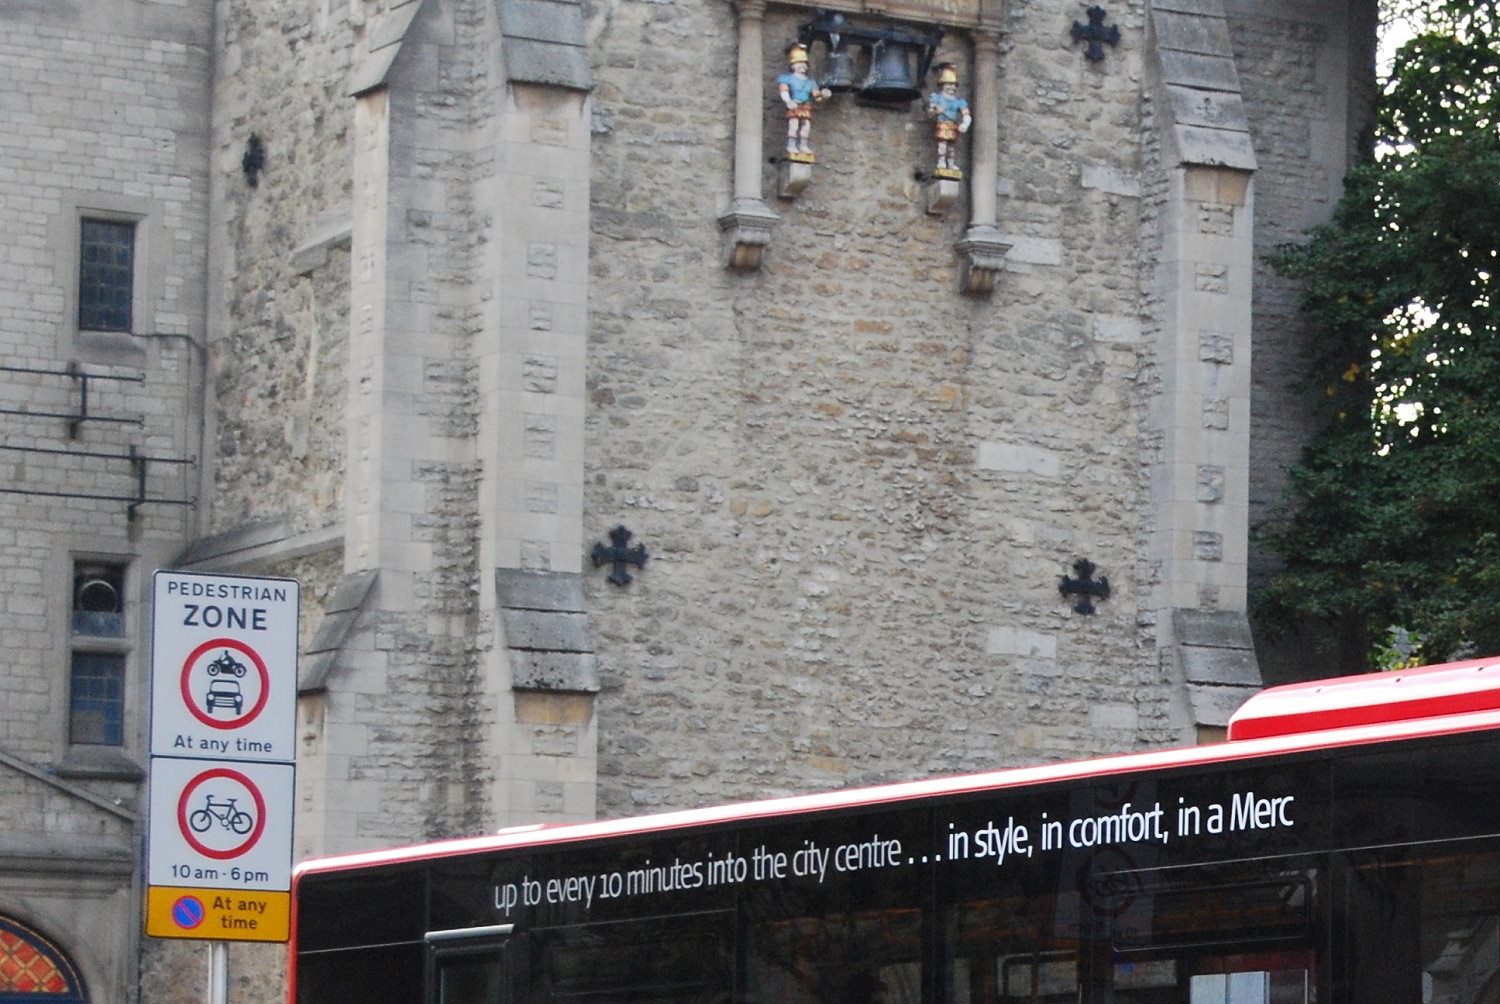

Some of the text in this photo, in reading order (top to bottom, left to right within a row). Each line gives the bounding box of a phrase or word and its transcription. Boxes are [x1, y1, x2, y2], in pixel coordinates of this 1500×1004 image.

[168, 581, 287, 602] PEDESTRIAN
[183, 604, 268, 631] ZONE
[174, 734, 273, 755] At any time
[494, 882, 518, 917] up
[522, 875, 542, 906] to
[546, 876, 596, 909] every
[599, 872, 621, 900] 10
[626, 858, 703, 897] minutes
[707, 851, 747, 887] into
[752, 843, 787, 881] the
[791, 838, 830, 883] city
[834, 831, 902, 873] centre
[948, 822, 968, 861] in
[974, 815, 1034, 866] style,
[1040, 811, 1062, 851] in
[1068, 801, 1170, 846] comfort,
[1177, 796, 1200, 837] in
[1206, 803, 1224, 835] a
[1229, 791, 1295, 832] Merc
[212, 896, 267, 914] At any
[221, 914, 257, 929] time
